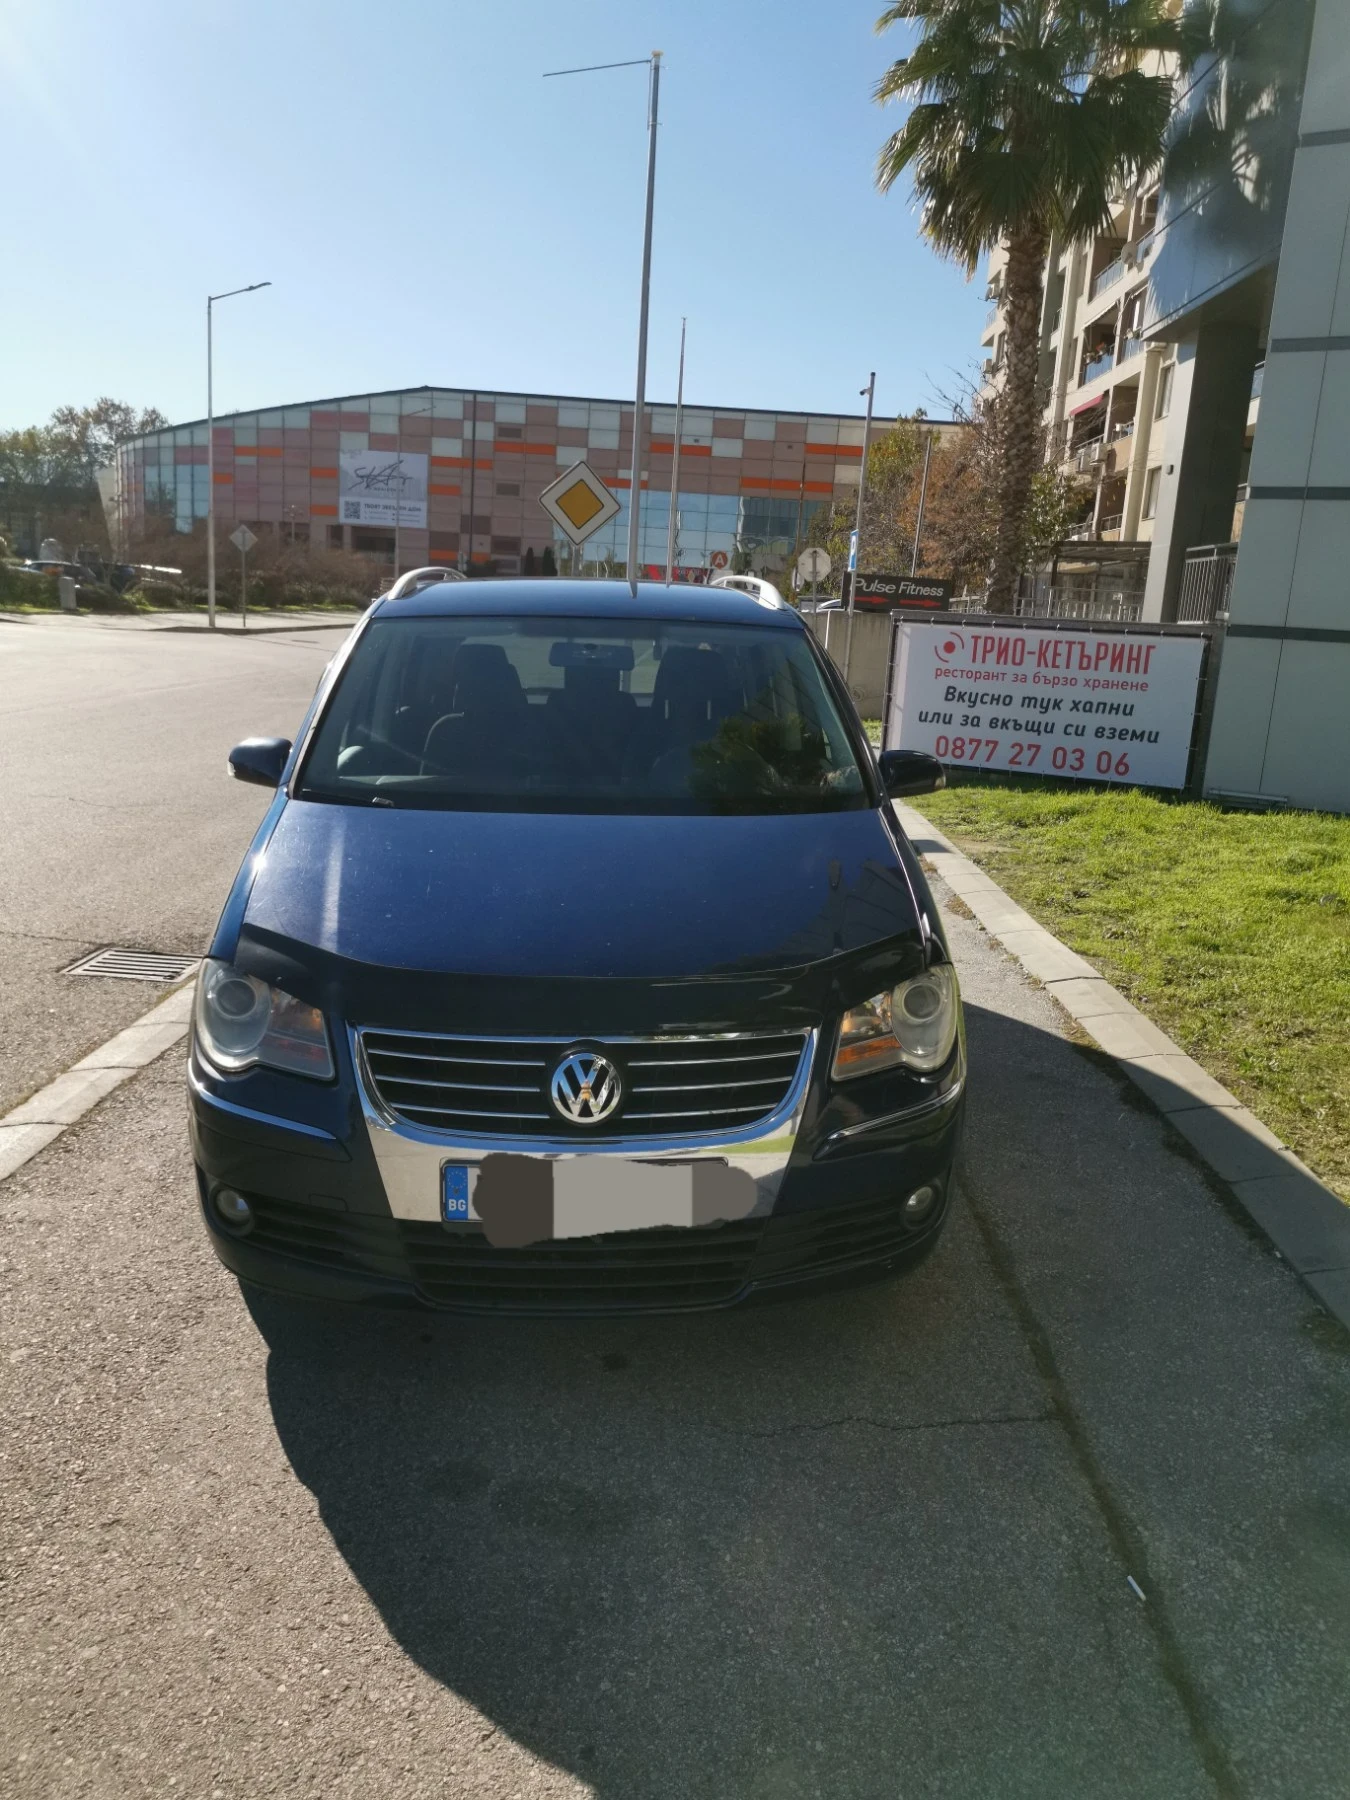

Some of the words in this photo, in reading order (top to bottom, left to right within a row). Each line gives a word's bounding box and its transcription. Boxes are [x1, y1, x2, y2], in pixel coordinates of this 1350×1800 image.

[854, 577, 897, 594] Pulse
[898, 581, 945, 597] Fitness
[970, 634, 1156, 675] ТРИО-КЕТЪРИНГ
[935, 667, 1007, 683] ресторант
[1011, 672, 1028, 684] за
[1032, 671, 1078, 689] бързо
[1083, 677, 1149, 692] хранене
[944, 685, 1013, 709] Вкусно
[1020, 696, 1064, 715] тук
[1069, 699, 1135, 717] хапни
[918, 710, 953, 726] или
[959, 713, 981, 728] за
[988, 716, 1056, 736] вкъщи
[1063, 722, 1087, 737] си
[1094, 726, 1160, 744] вземи
[935, 735, 999, 763] 0877
[1008, 742, 1042, 767] 27
[1052, 746, 1086, 772] 03
[1096, 750, 1130, 777] 06
[448, 1198, 467, 1212] BG
